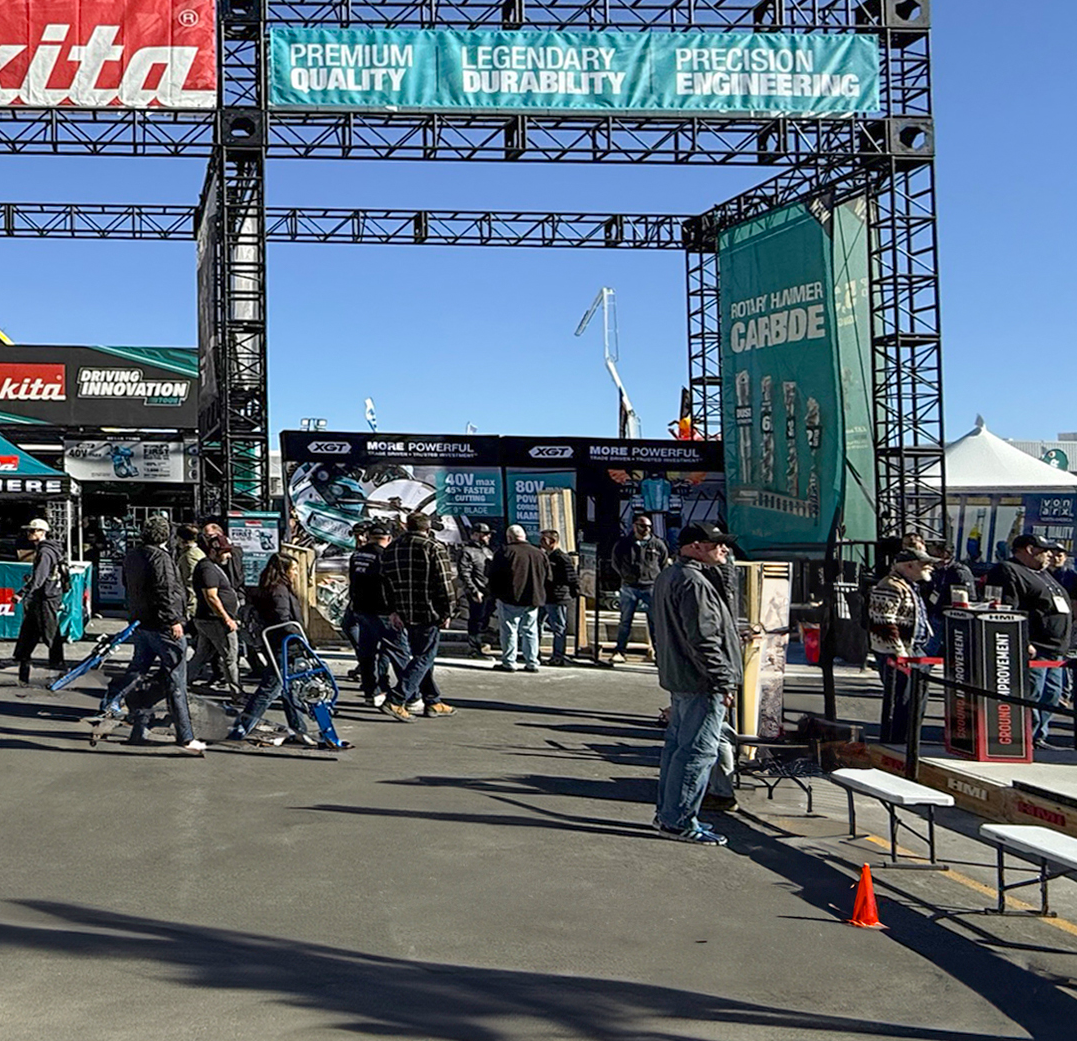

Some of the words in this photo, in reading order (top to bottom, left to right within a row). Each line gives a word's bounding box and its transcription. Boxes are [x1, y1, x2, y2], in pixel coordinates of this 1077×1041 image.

[289, 43, 413, 69] PREMIUM
[461, 45, 615, 70] LEGENDARY
[676, 47, 814, 73] PRECISION
[290, 67, 407, 92] QUALITY
[462, 69, 626, 96] DURABILITY
[676, 71, 860, 98] ENGINEERING
[80, 370, 140, 382] DRIVING
[81, 382, 187, 397] INNOVATION
[312, 442, 348, 452] XGT
[366, 441, 405, 451] MORE
[408, 442, 474, 453] POWERFUL
[534, 447, 569, 457] XGT
[589, 446, 628, 456] MORE
[632, 447, 700, 458] POWERFUL
[444, 473, 474, 486] 40V
[463, 487, 495, 495] FASTER
[515, 480, 545, 493] 80V
[454, 494, 486, 502] CUTTING
[464, 506, 488, 515] BLADE
[953, 629, 965, 698] IPROVEMENT
[995, 631, 1011, 702] PROVEMENT
[998, 703, 1012, 746] GROUND
[947, 777, 989, 802] HMI
[1017, 800, 1067, 828] HMI
